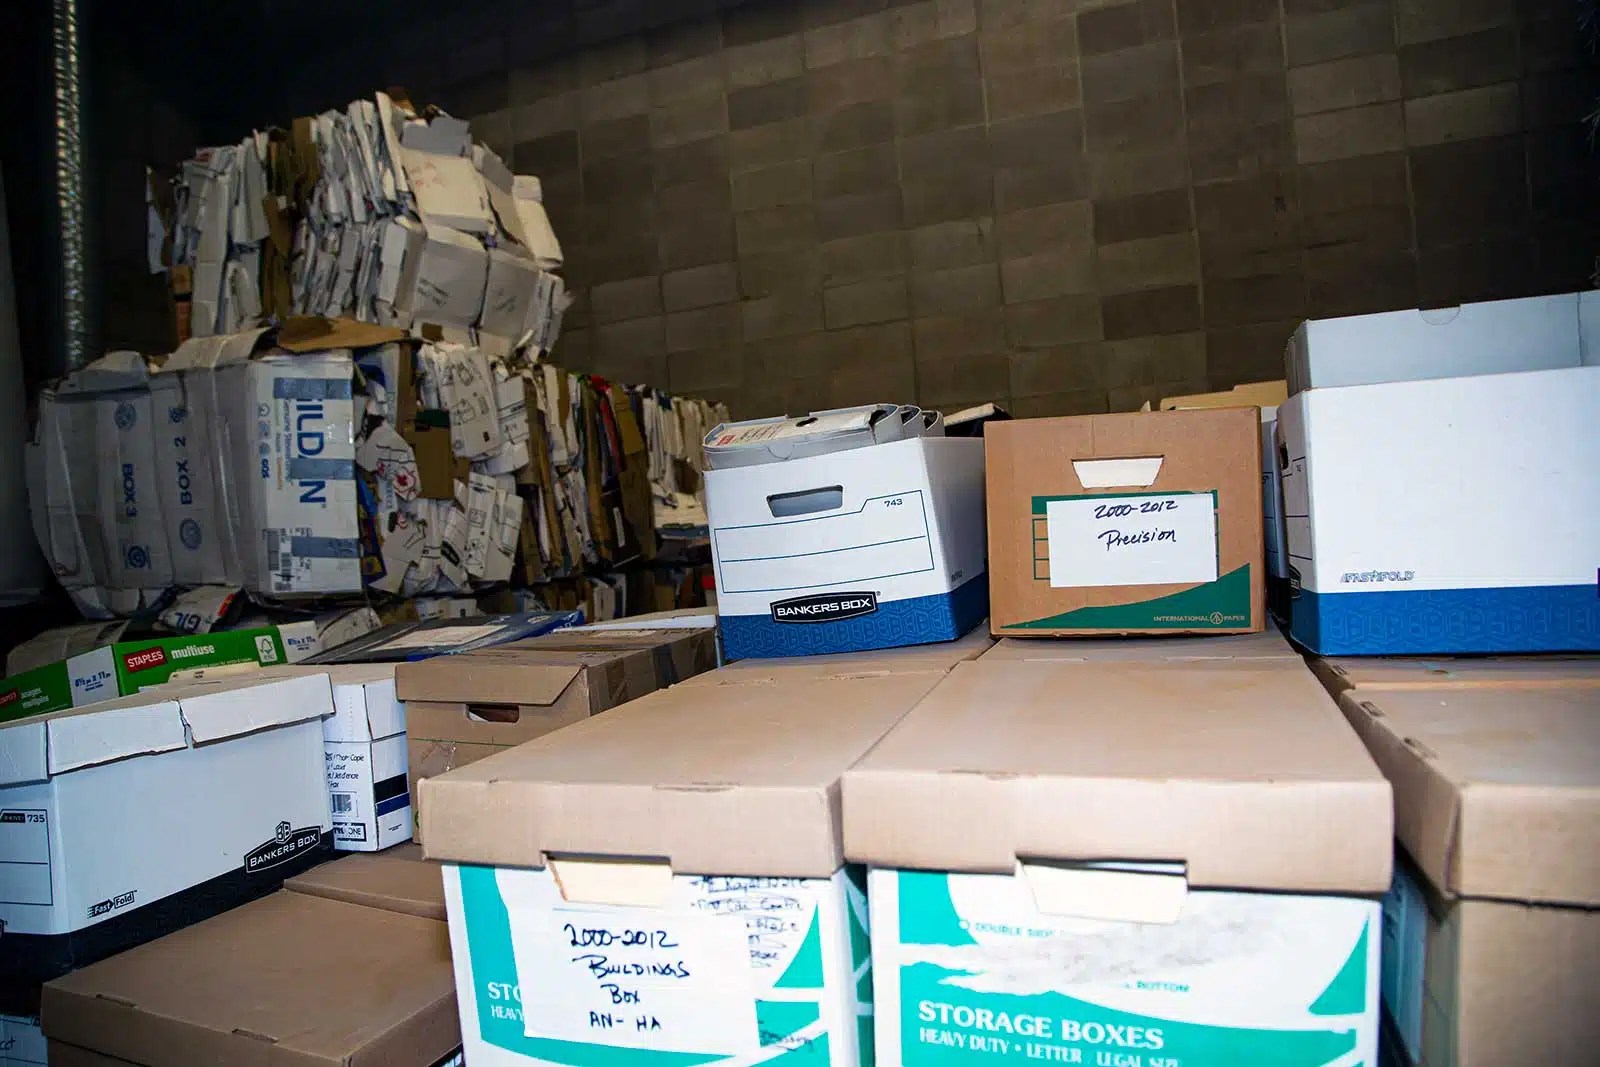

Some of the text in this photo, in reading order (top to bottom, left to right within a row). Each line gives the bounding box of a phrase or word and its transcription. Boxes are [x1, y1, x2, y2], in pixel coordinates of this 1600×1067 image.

[296, 398, 327, 503] ILDN
[175, 459, 193, 505] BOX
[884, 498, 903, 508] 743
[1094, 500, 1178, 519] 2000-2012
[1097, 527, 1177, 551] Precision
[777, 598, 872, 616] BANKERS BOX
[1223, 614, 1246, 622] PAPER
[127, 650, 164, 668] STAPLES
[171, 644, 215, 659] multiuse
[27, 814, 45, 823] 735
[249, 832, 317, 868] BANKERS BOX
[115, 892, 133, 907] Fold
[563, 923, 680, 949] 2000-2012
[918, 1000, 1164, 1050] STORAGE BOXES
[919, 1027, 967, 1048] HEAVY
[969, 1034, 1009, 1054] DUTY
[1026, 1043, 1083, 1063] LETTER
